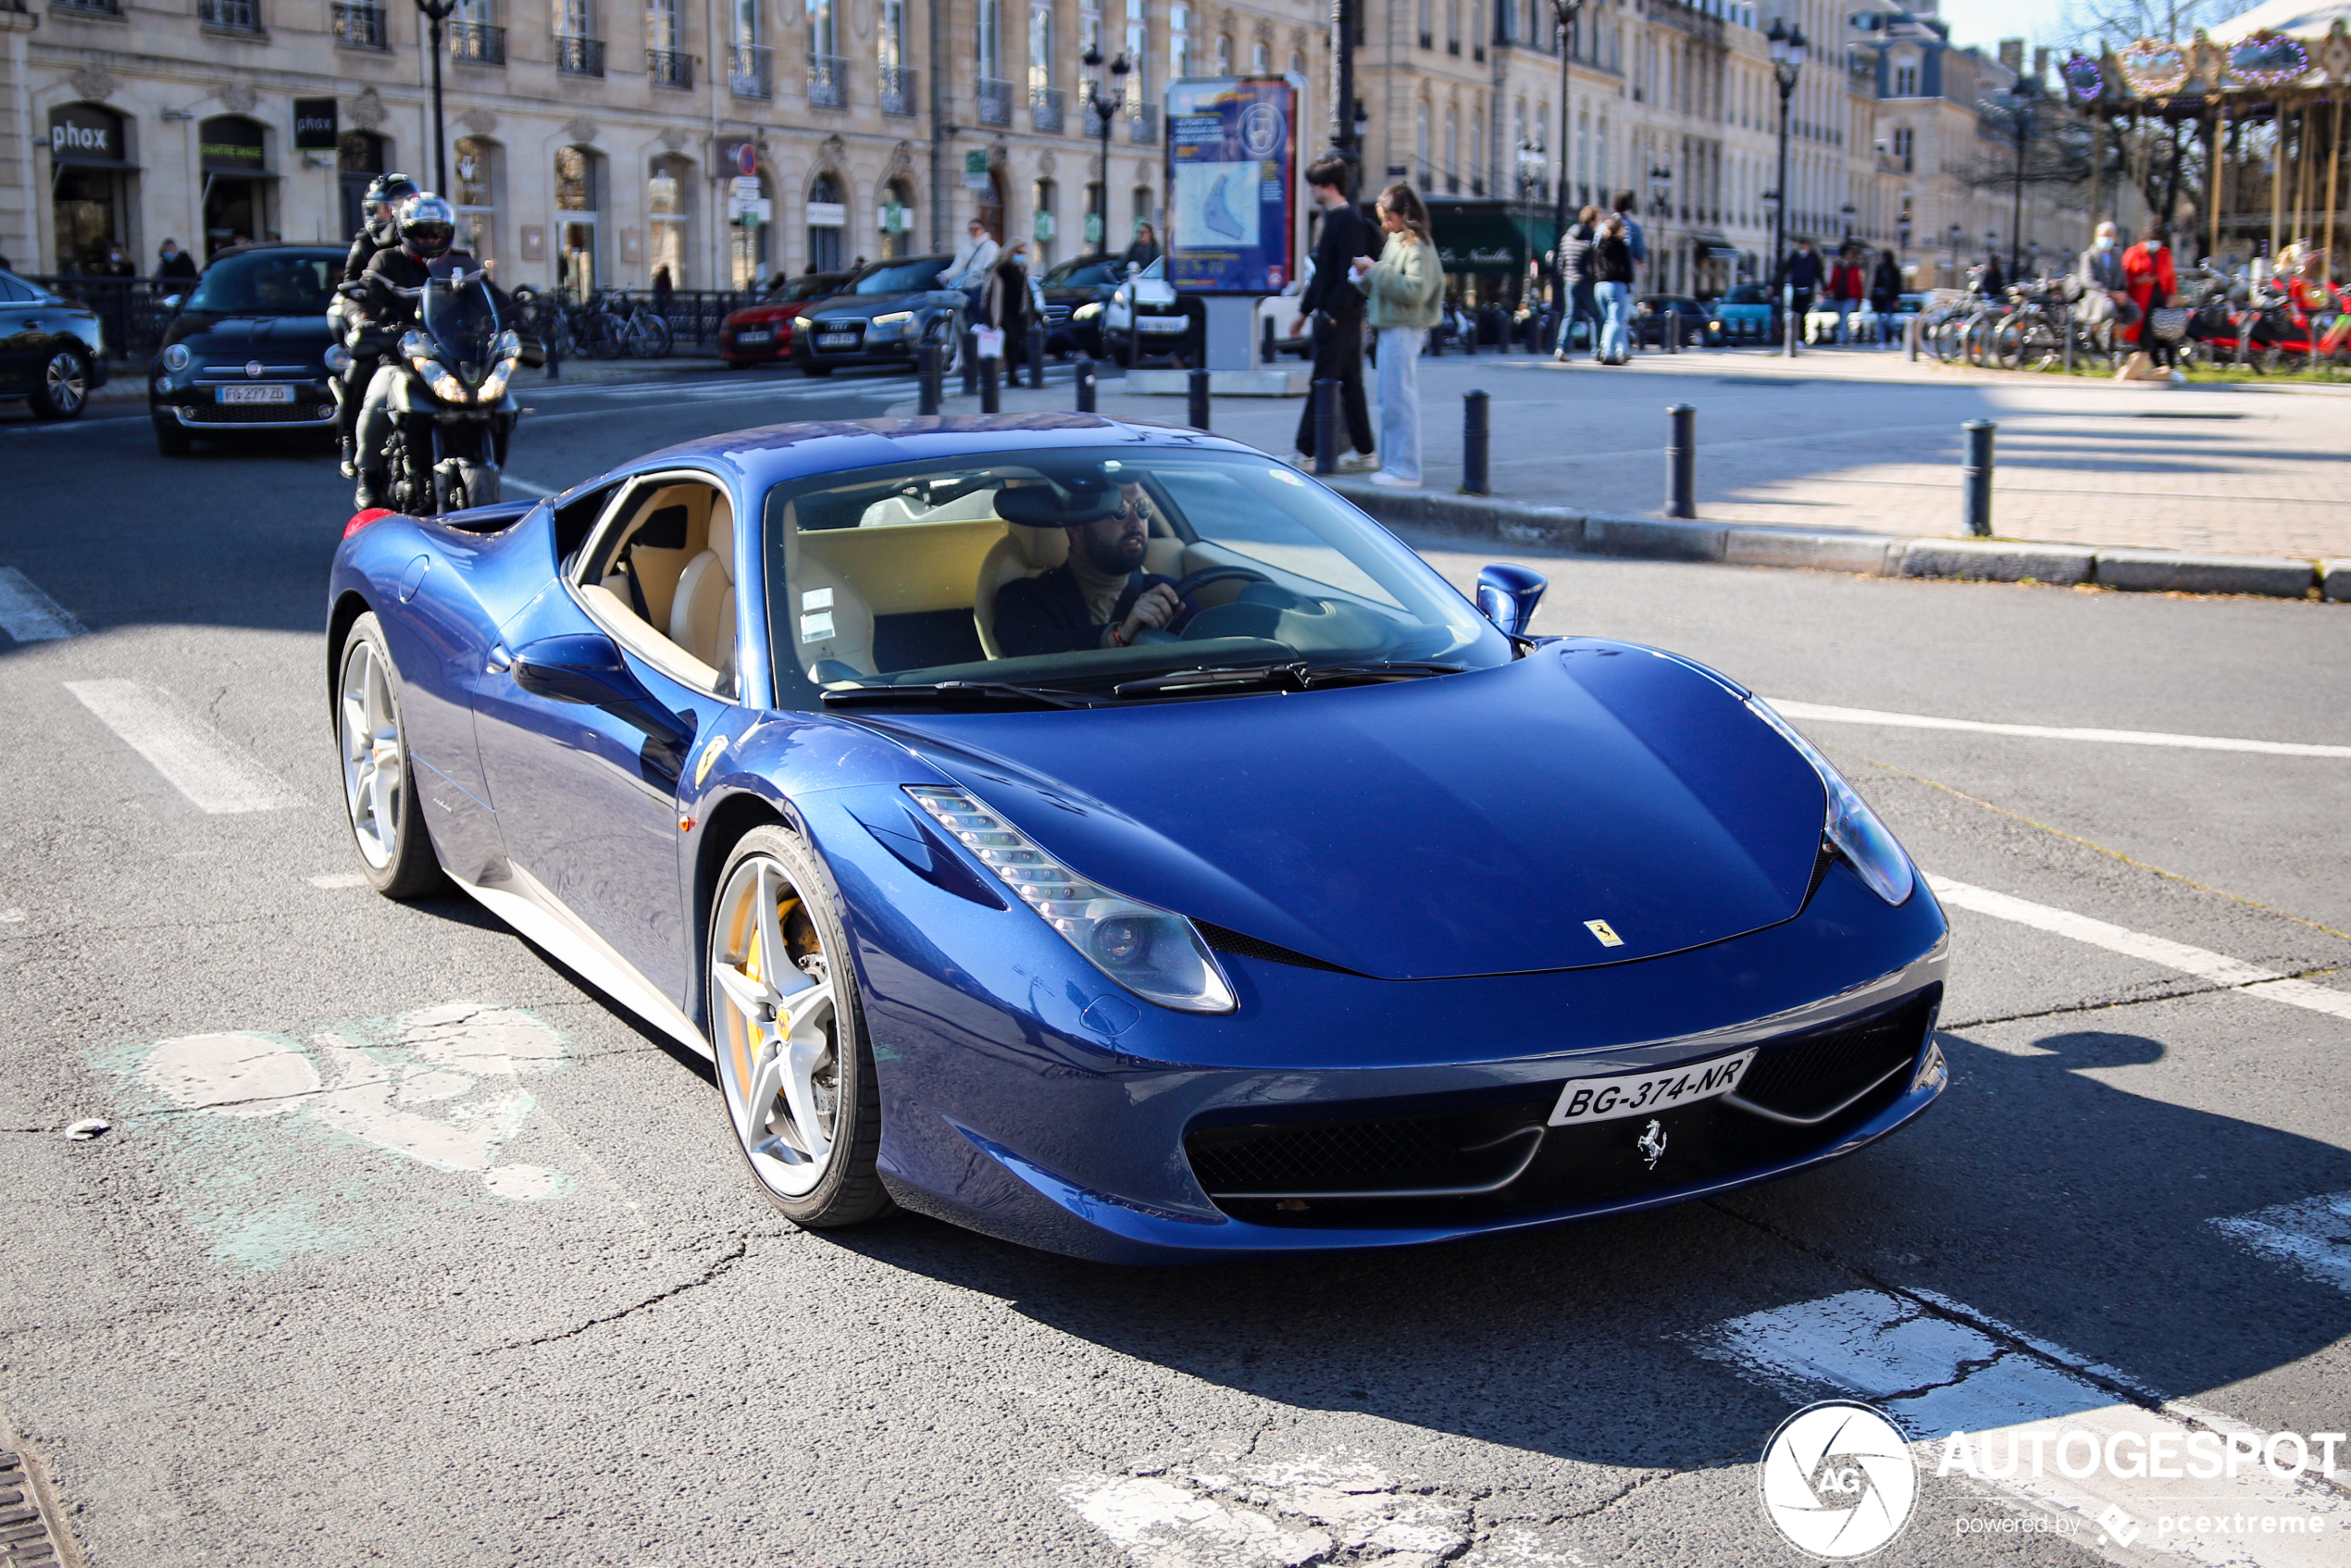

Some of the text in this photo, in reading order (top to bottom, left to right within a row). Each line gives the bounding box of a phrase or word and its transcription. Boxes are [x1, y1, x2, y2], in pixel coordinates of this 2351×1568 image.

[52, 119, 108, 152] phox
[298, 115, 332, 134] phox
[1563, 1058, 1744, 1119] BG-374-NR
